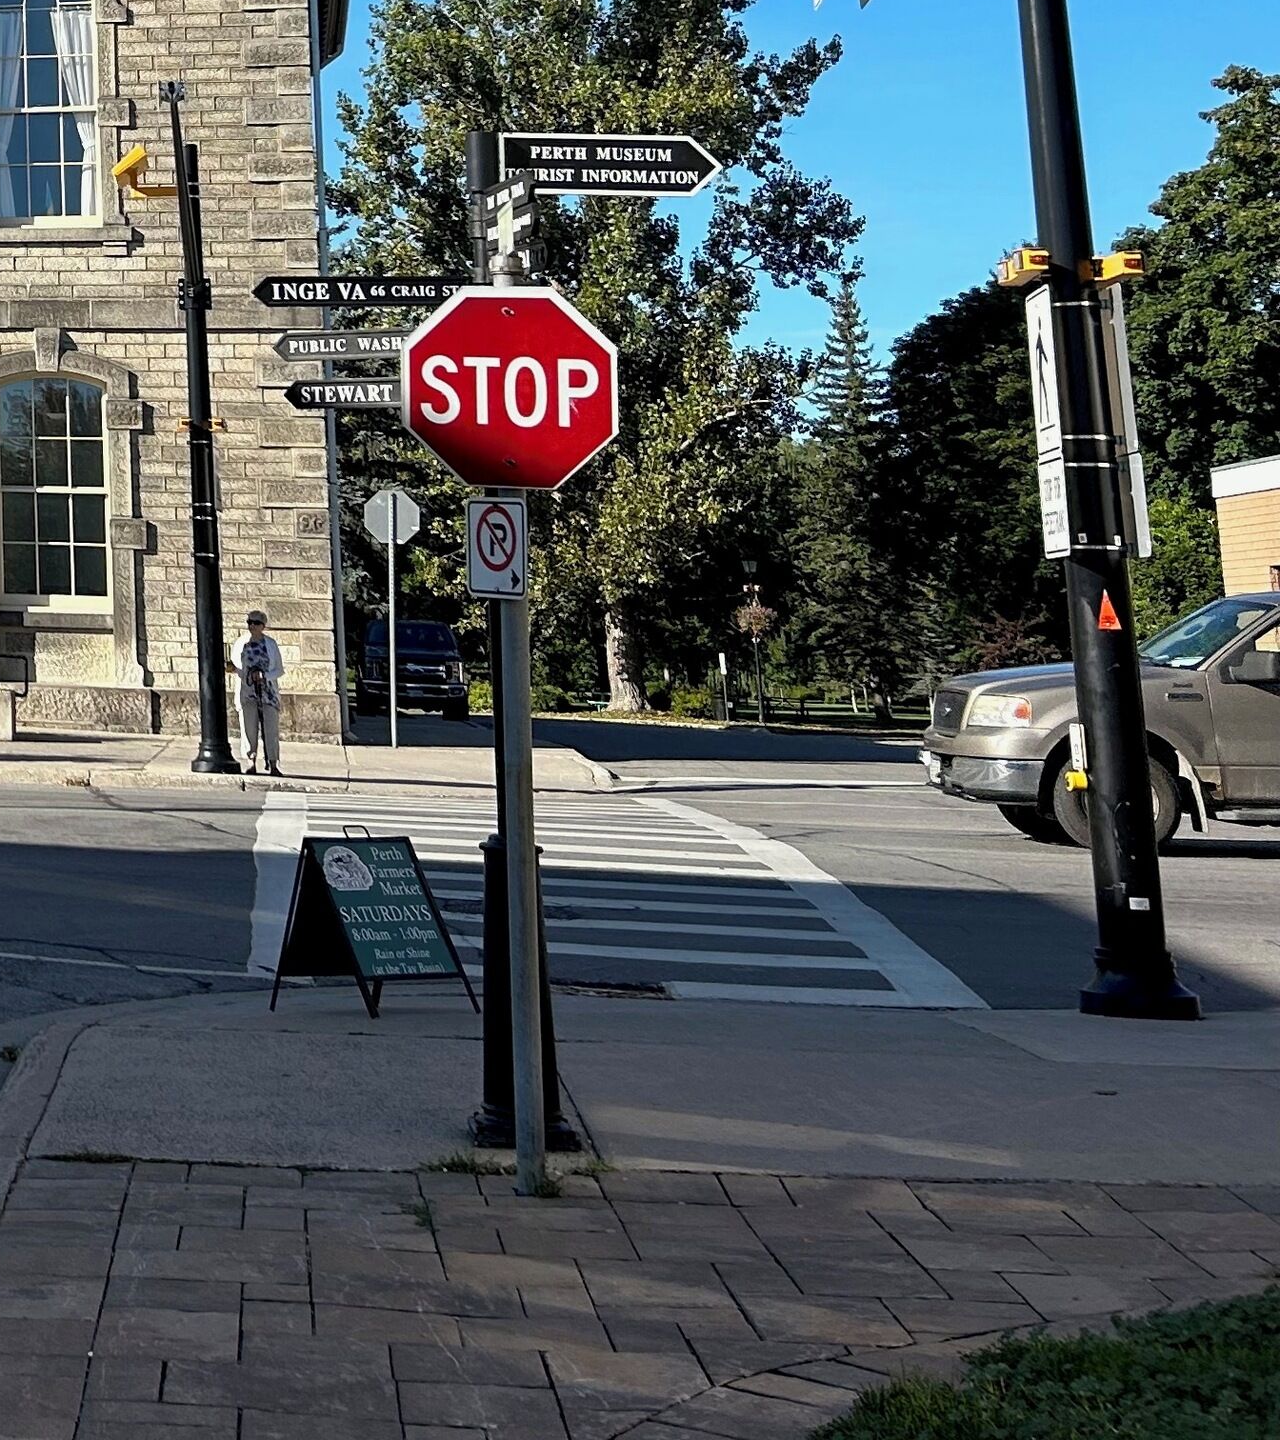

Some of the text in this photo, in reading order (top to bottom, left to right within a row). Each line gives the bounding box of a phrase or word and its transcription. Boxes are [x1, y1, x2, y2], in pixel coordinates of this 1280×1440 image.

[530, 146, 672, 161] PERTH MUSEUM
[581, 169, 699, 184] INFORMATION
[272, 283, 330, 300] INGE
[337, 283, 367, 300] VA
[370, 285, 385, 297] 66
[391, 285, 436, 297] CRAIG
[289, 336, 408, 354] PUBLIC WASH
[301, 384, 393, 403] STEWART
[420, 355, 600, 428] STOP
[370, 846, 404, 861] Perth
[379, 881, 422, 896] Market
[340, 904, 432, 923] SATURDAYS
[351, 928, 391, 941] 8:00am
[399, 926, 438, 943] 1:00pm
[374, 947, 431, 960] Rain or Shine
